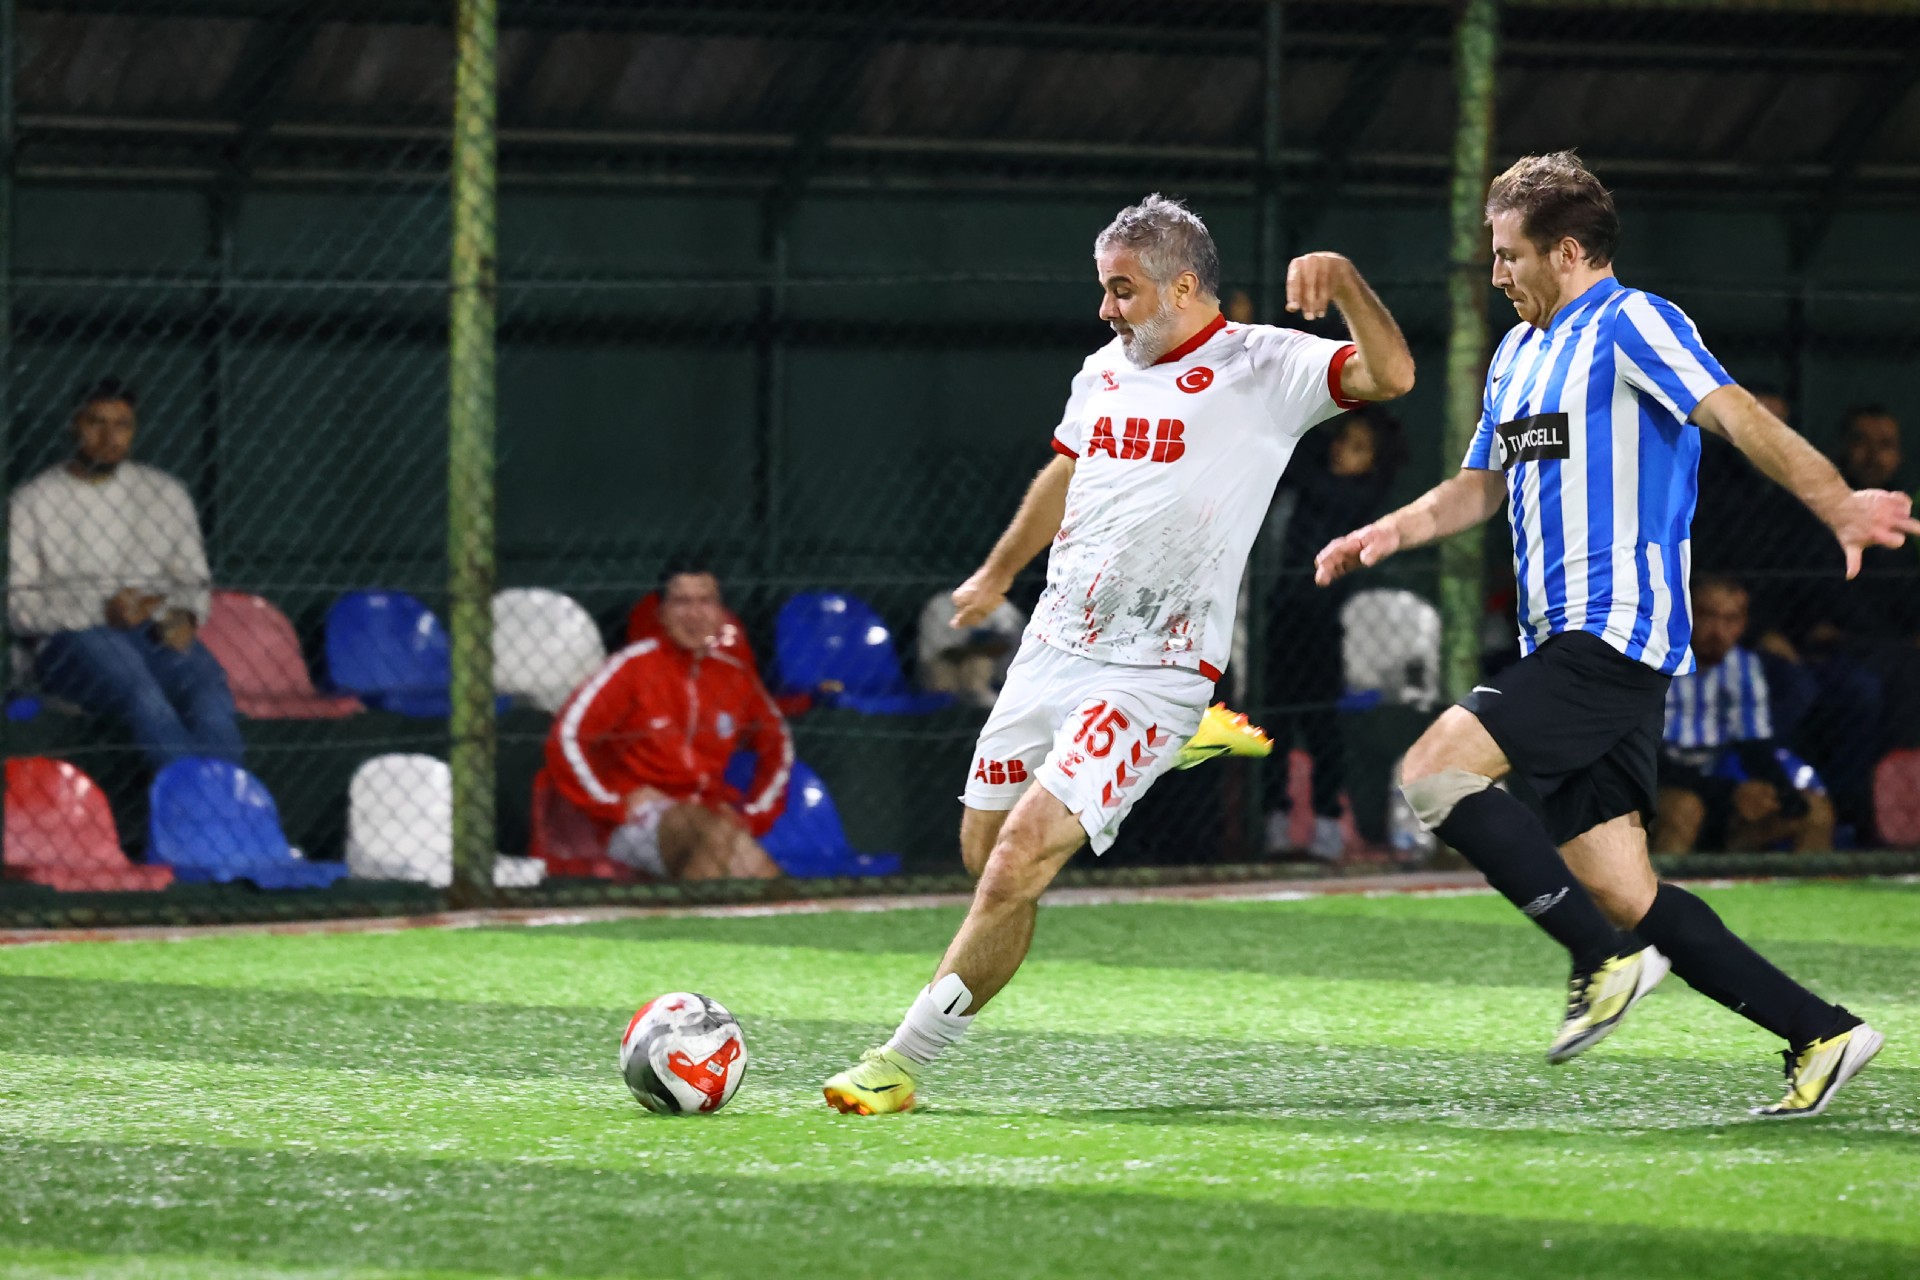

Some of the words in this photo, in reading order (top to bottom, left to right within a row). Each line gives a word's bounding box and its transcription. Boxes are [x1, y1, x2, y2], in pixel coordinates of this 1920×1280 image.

[1088, 417, 1185, 463] ABB
[1507, 428, 1563, 453] TUKCELL
[1073, 699, 1130, 760] 15
[974, 757, 1028, 785] ABB
